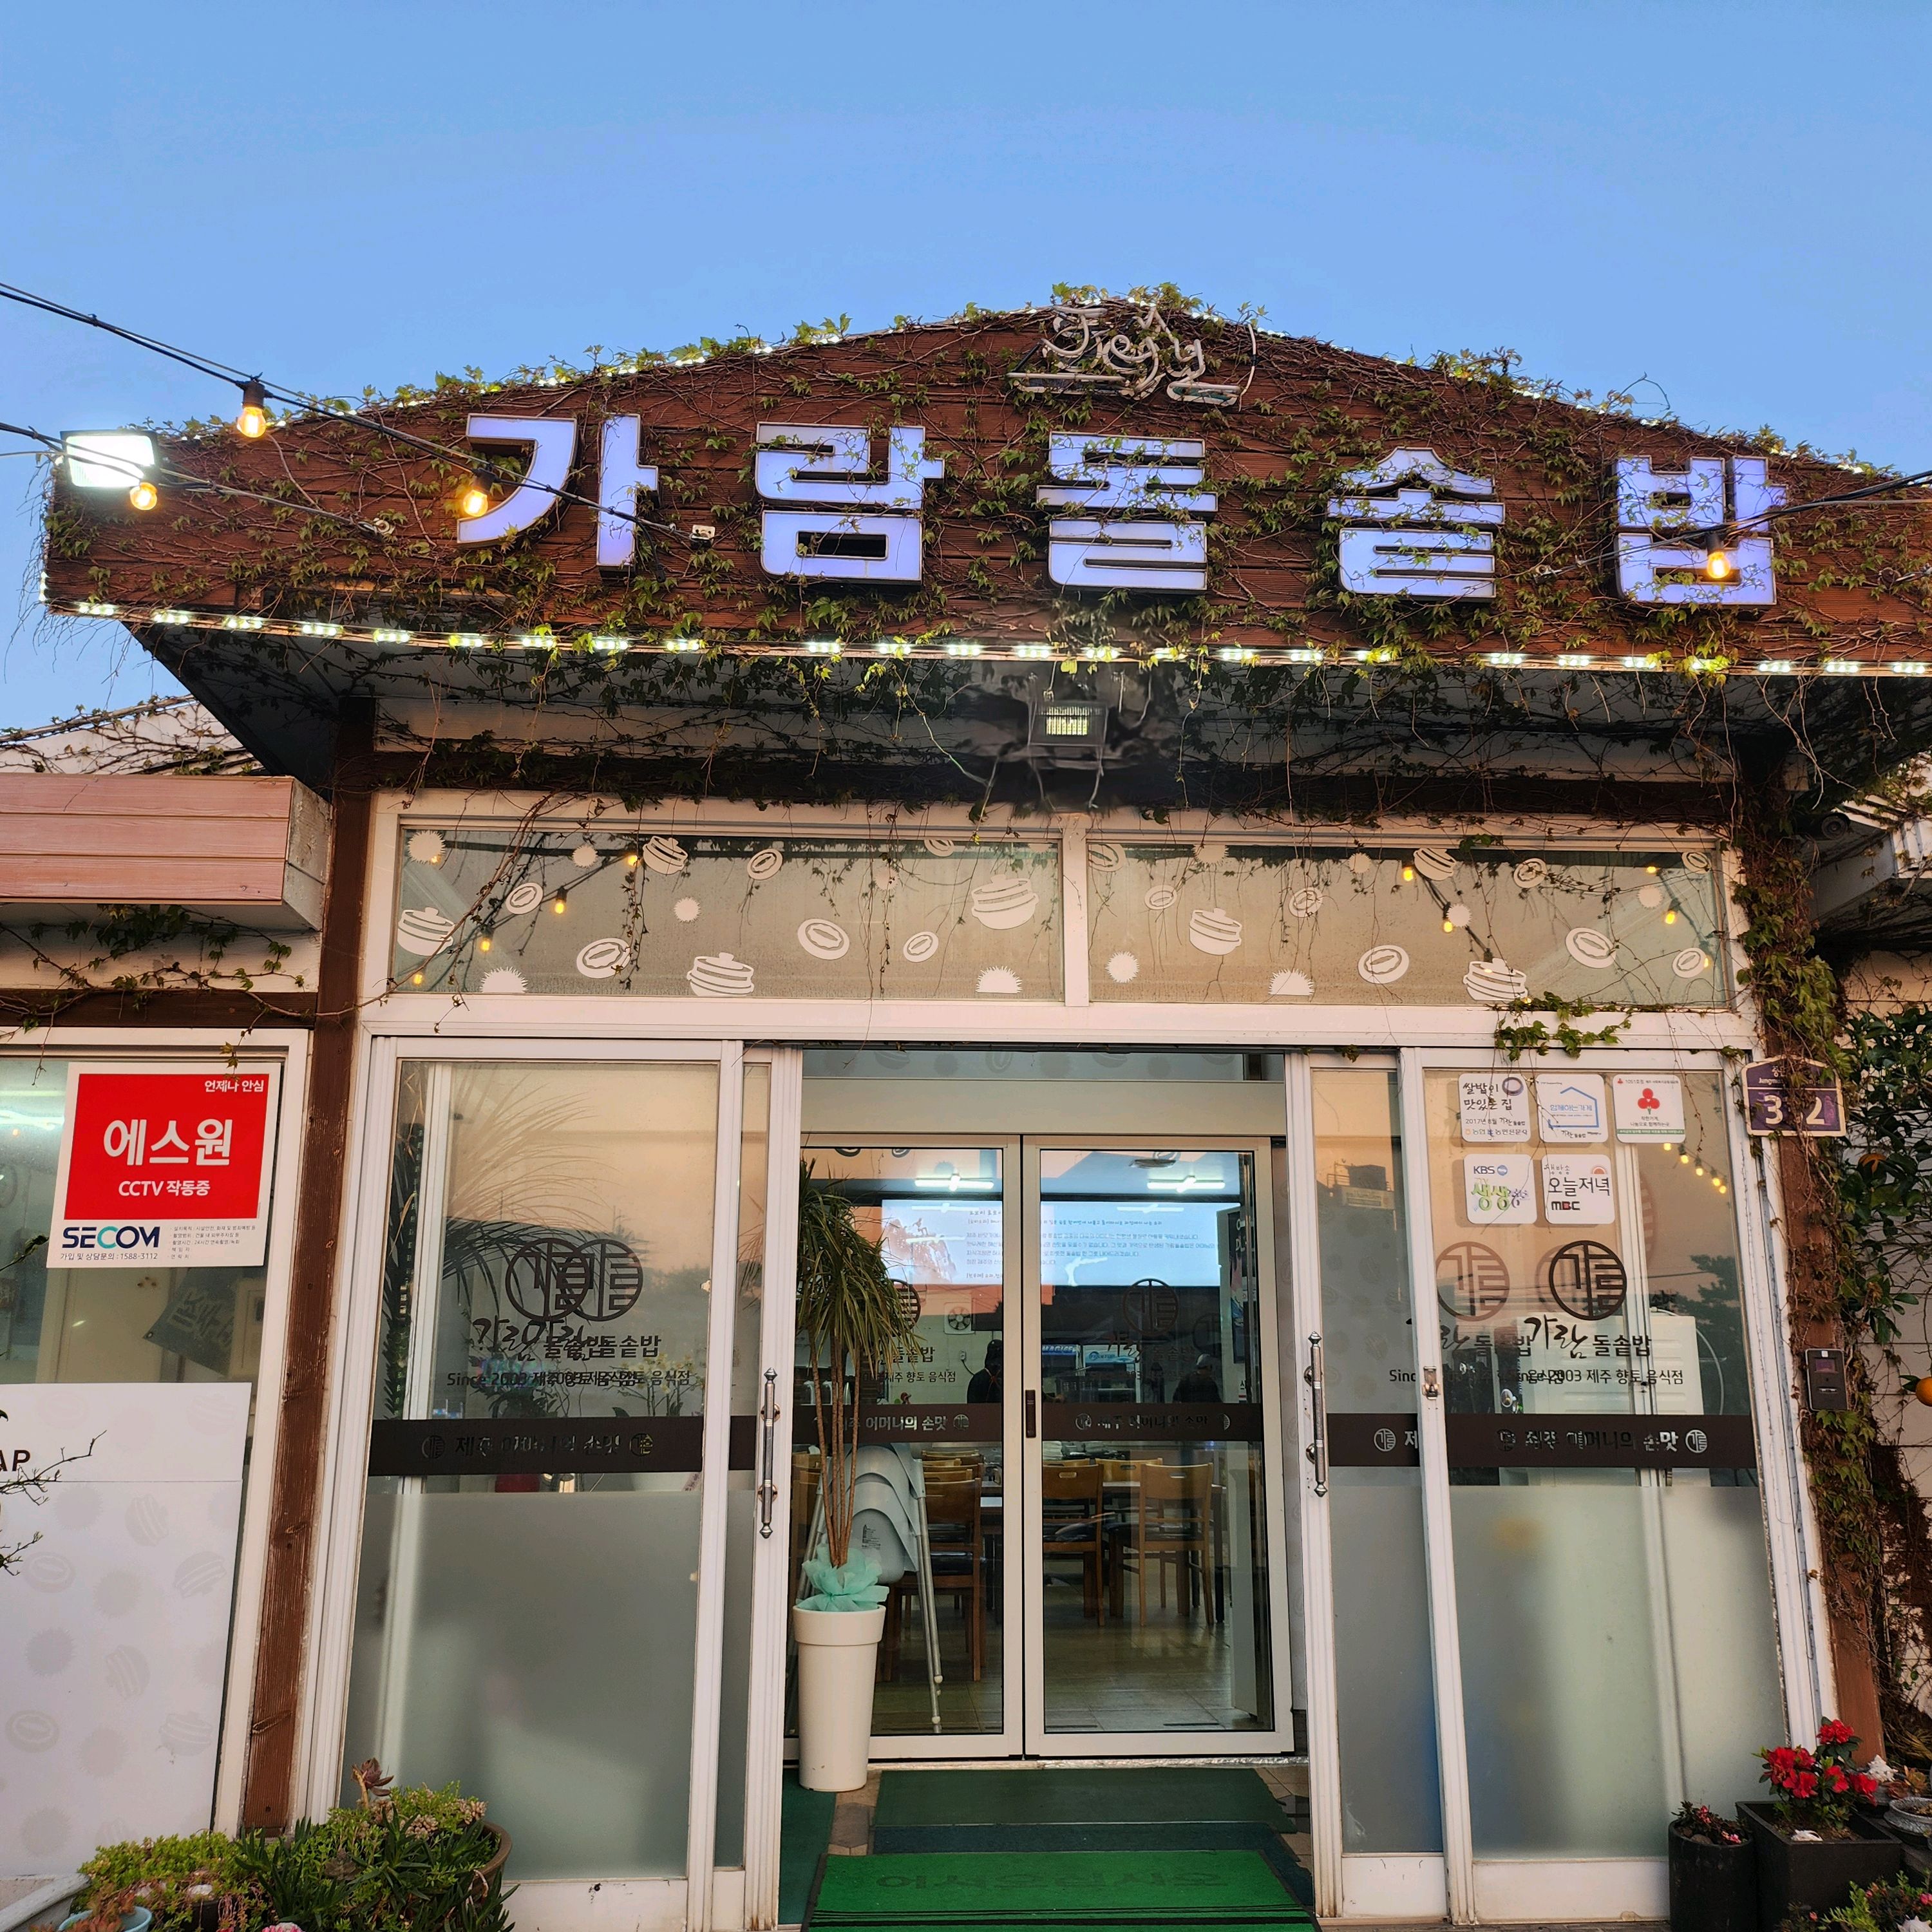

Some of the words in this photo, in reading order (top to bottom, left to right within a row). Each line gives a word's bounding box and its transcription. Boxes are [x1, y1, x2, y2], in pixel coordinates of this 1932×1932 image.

[205, 1079, 238, 1092] 언제나
[242, 1079, 263, 1092] 안심
[1463, 1083, 1499, 1094] 쌀밥이
[1464, 1099, 1497, 1110] 맛있는
[1501, 1099, 1512, 1110] 집
[103, 1119, 232, 1166] 에스원
[1473, 1166, 1495, 1174] KBS
[118, 1181, 164, 1196] CCTV
[166, 1180, 211, 1196] 작동중
[1548, 1177, 1610, 1197] 오늘저녁
[62, 1226, 160, 1249] SECOM
[1524, 1314, 1588, 1359] 가람
[1593, 1334, 1652, 1357] 돌솥밥
[928, 1371, 956, 1383] 음식점
[1586, 1369, 1612, 1383] 제주
[1646, 1370, 1683, 1385] 음식점
[866, 1416, 918, 1431] 어머니의
[922, 1416, 948, 1431] 손맛
